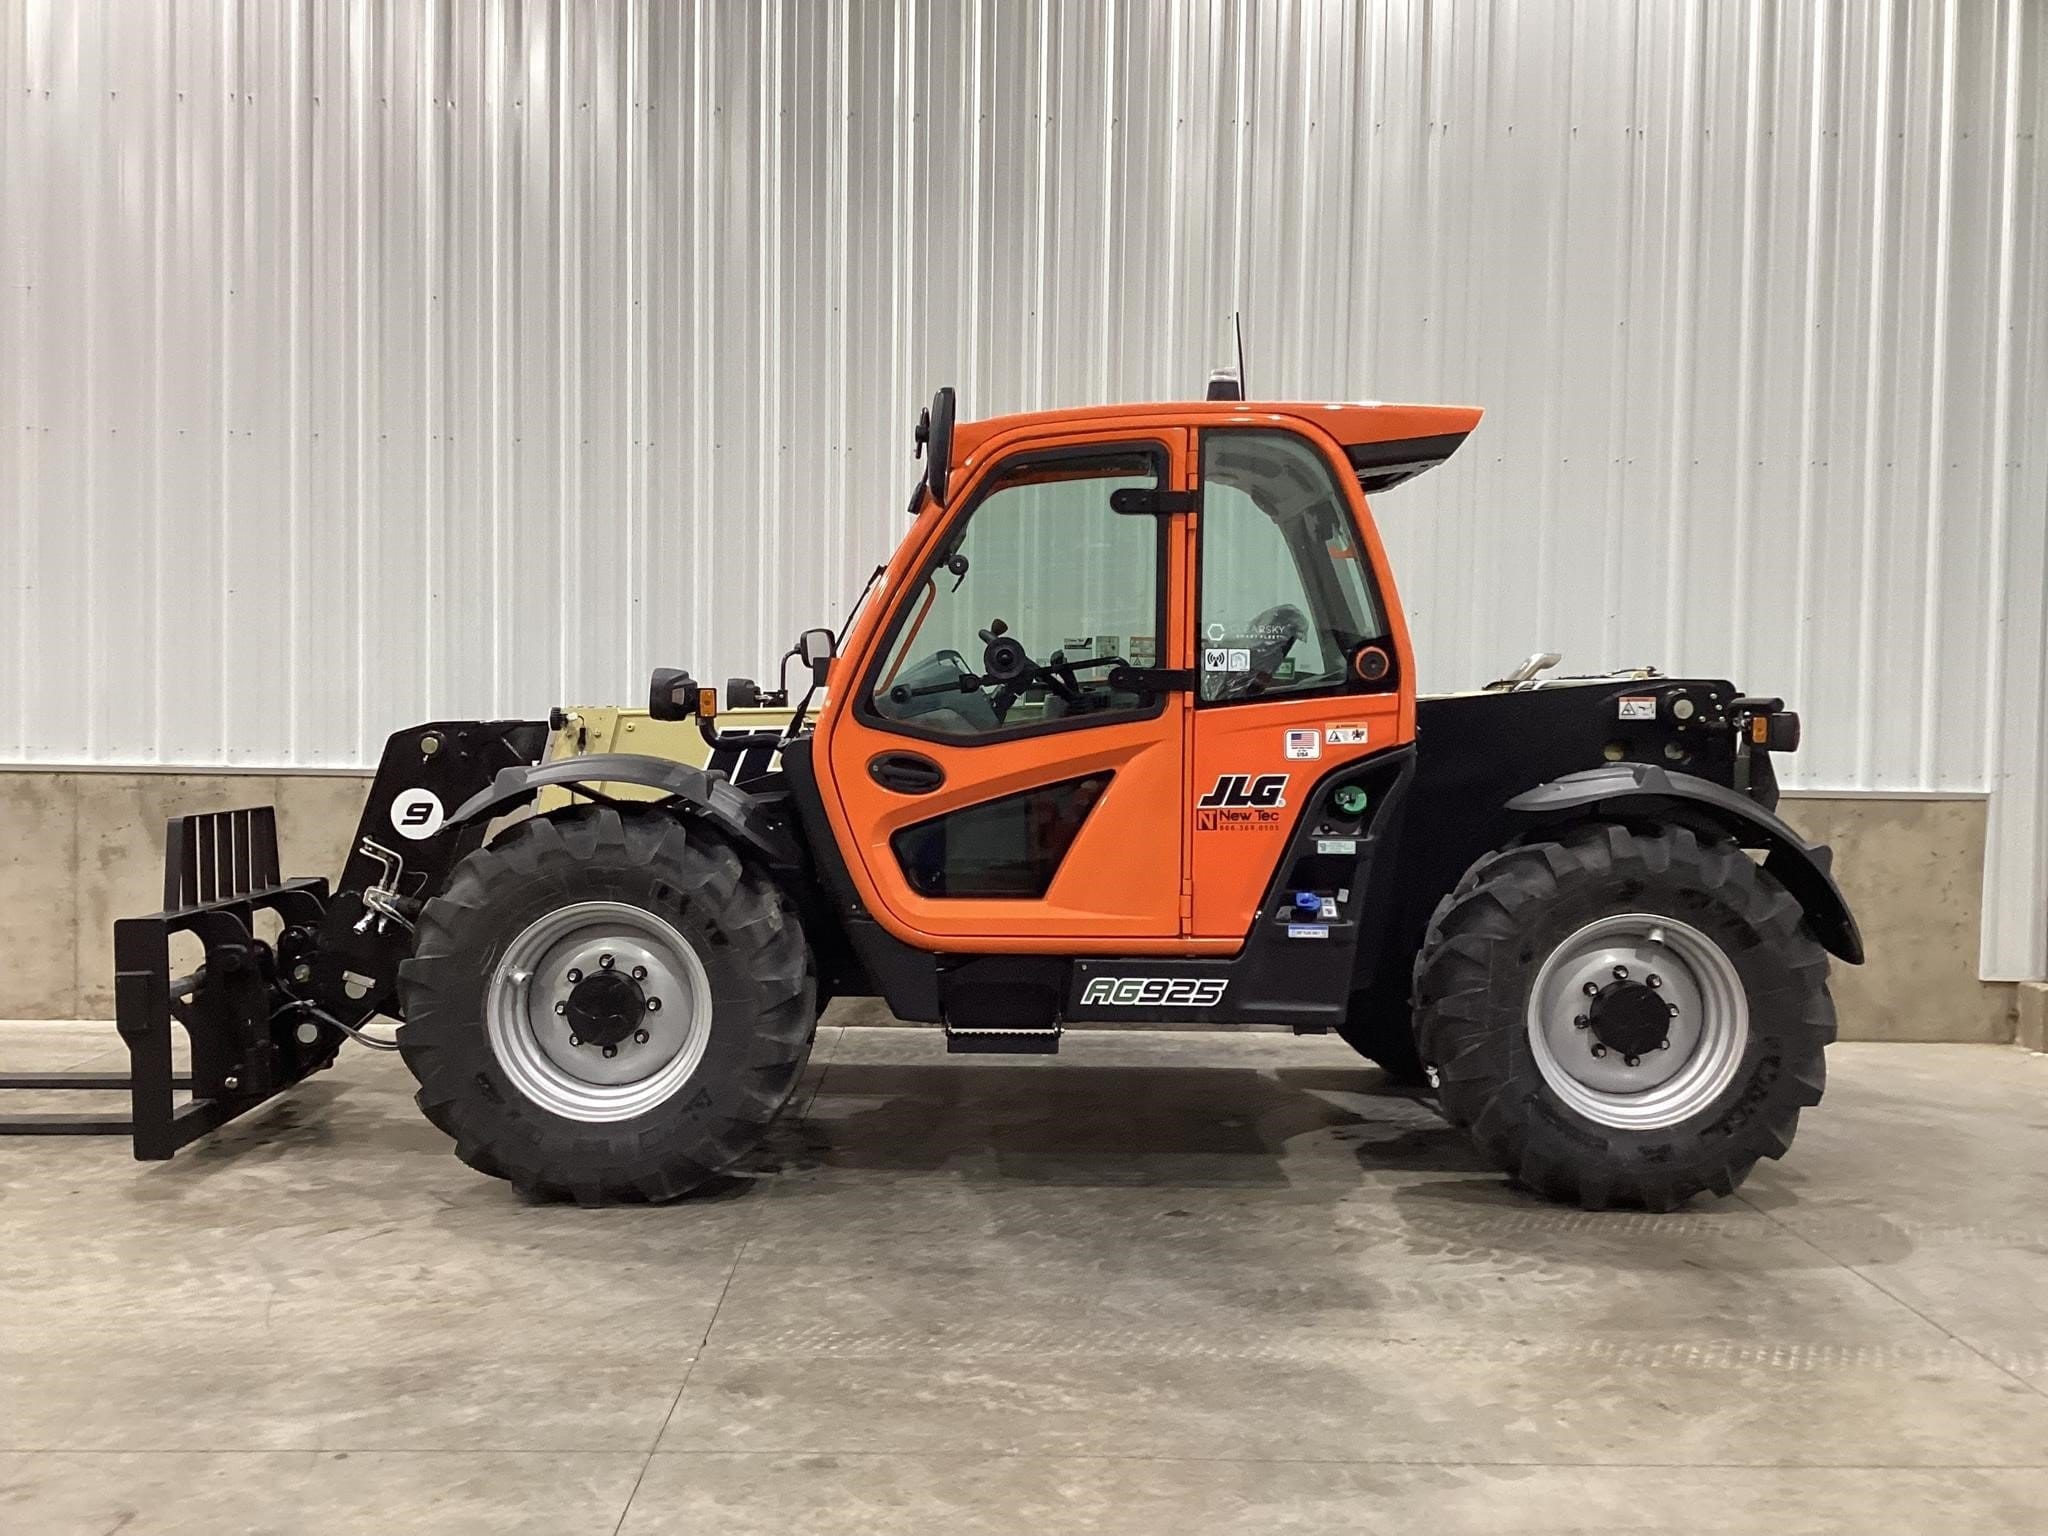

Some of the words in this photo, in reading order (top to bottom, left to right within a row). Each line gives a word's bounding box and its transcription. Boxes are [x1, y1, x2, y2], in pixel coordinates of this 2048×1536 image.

[1198, 775, 1290, 807] JLG
[400, 802, 434, 826] 9
[1219, 810, 1252, 821] New
[1255, 810, 1280, 821] Tec
[1080, 977, 1229, 1007] AG925
